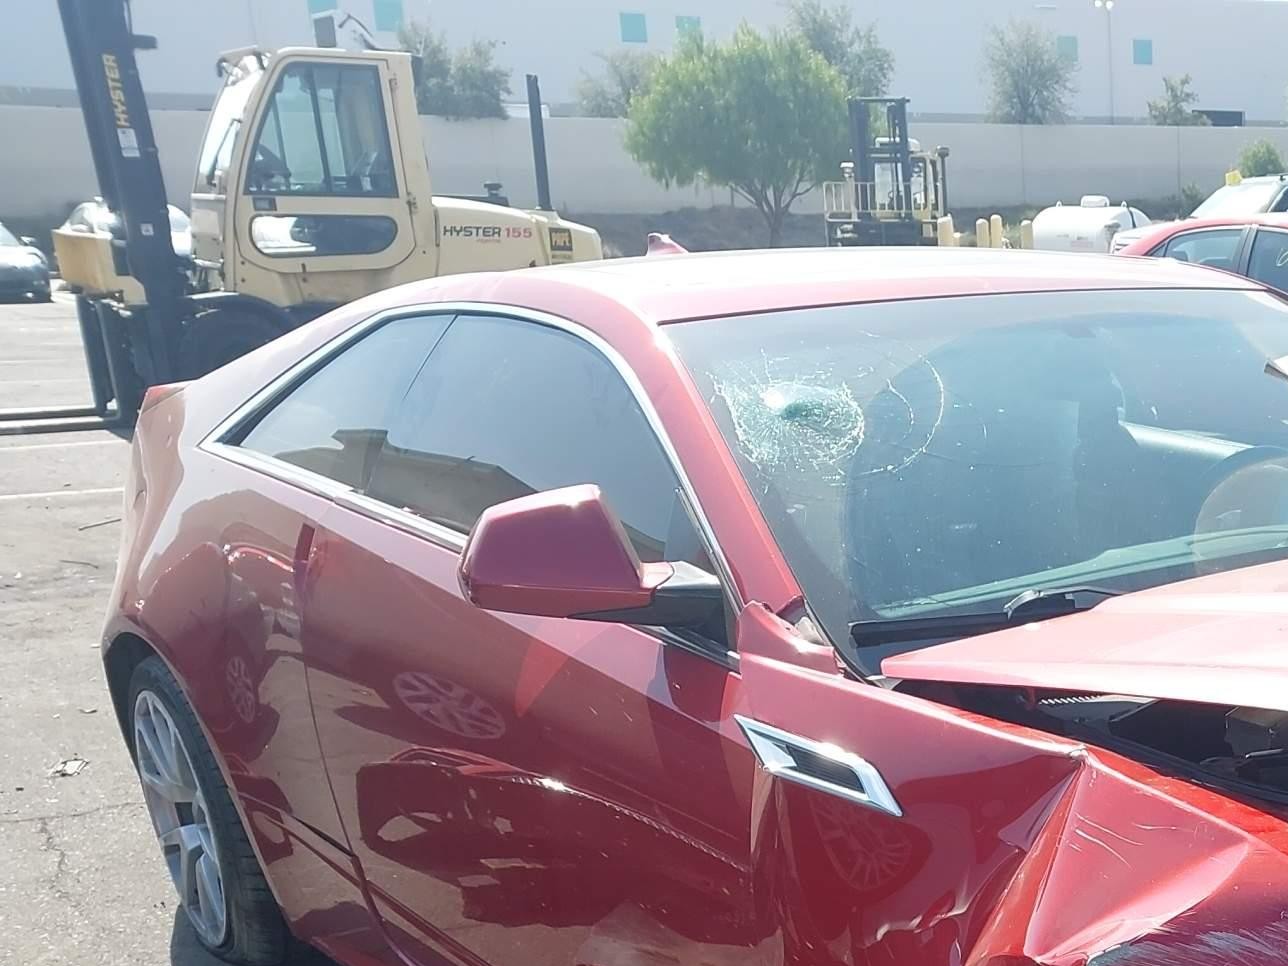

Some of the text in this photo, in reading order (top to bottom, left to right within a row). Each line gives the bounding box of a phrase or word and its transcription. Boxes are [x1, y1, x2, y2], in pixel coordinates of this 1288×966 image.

[102, 53, 130, 128] HYSTER
[443, 225, 533, 238] HYSTER 155
